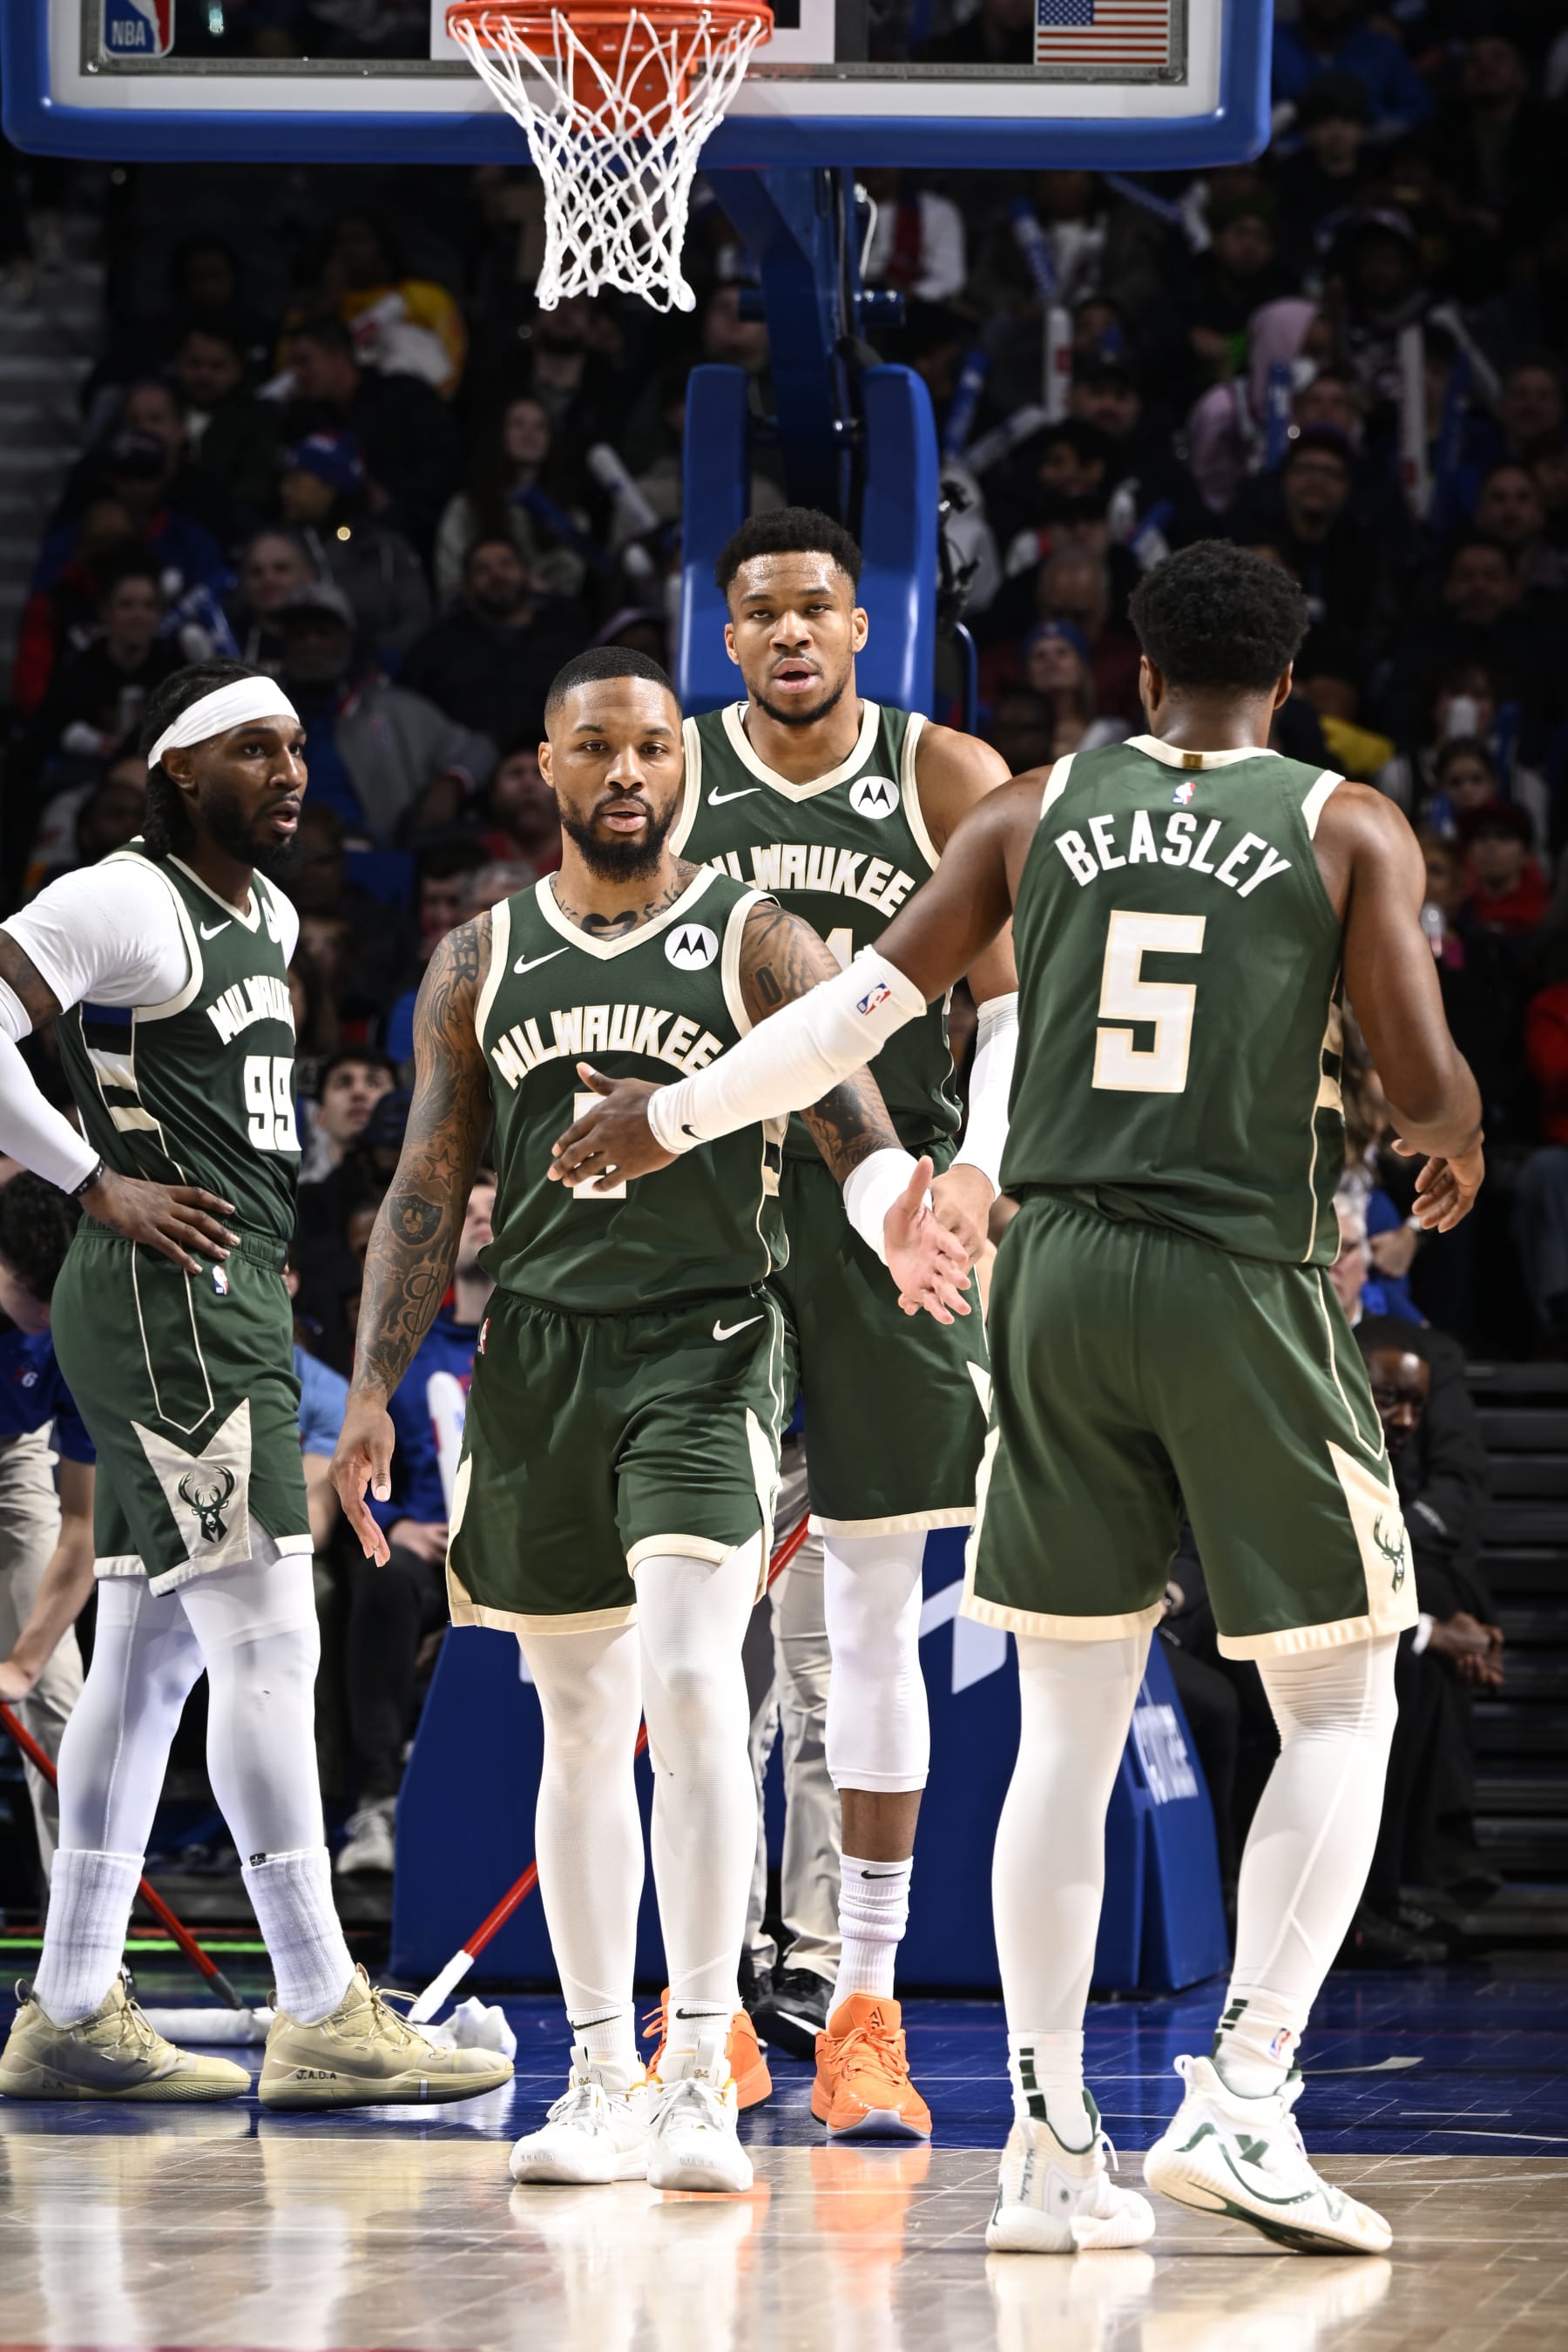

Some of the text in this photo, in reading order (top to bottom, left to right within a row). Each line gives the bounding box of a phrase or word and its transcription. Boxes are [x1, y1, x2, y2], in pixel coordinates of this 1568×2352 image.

[112, 20, 146, 46] NBA
[701, 844, 916, 918] ILWAUKEE
[1054, 810, 1292, 898] BEASLEY
[1092, 910, 1206, 1092] 5
[490, 1004, 724, 1090] MILWAUKEE
[244, 1055, 302, 1151] 99
